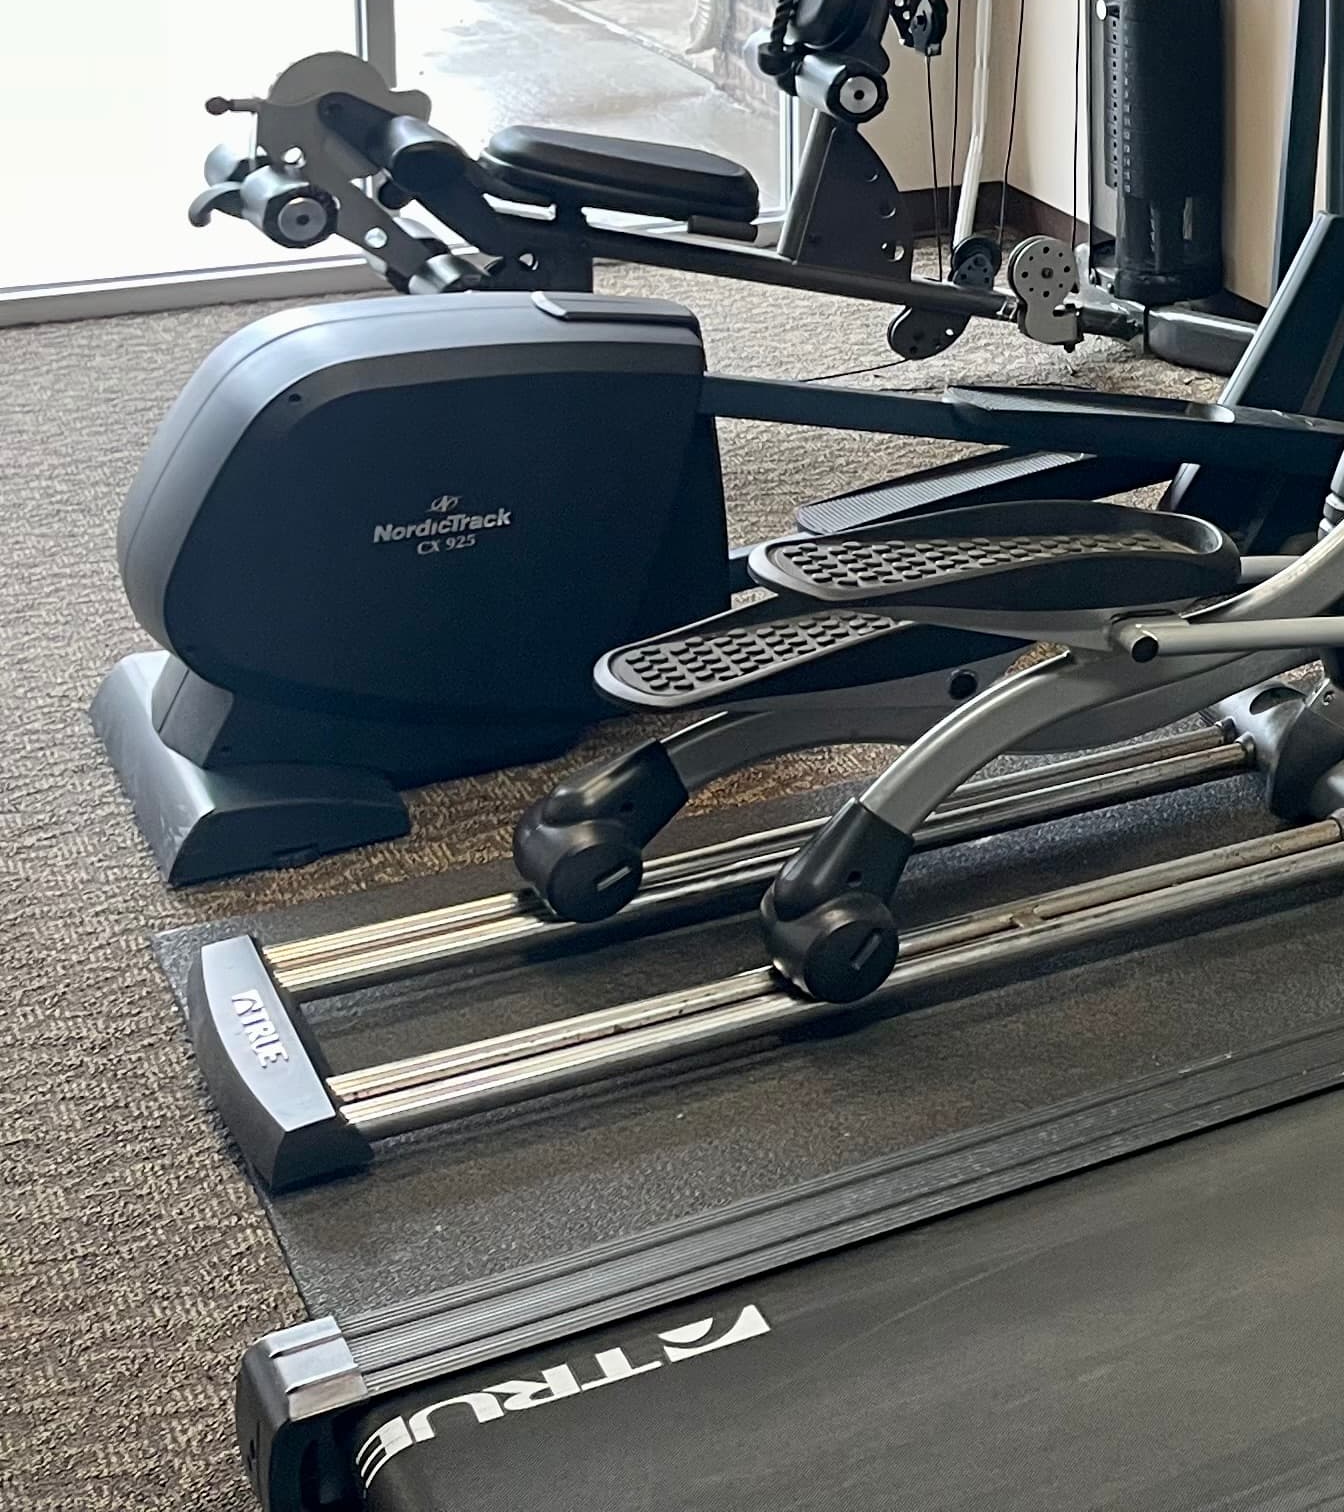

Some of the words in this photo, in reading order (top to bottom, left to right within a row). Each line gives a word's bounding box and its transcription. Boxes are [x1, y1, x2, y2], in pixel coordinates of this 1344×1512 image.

[373, 508, 511, 543] NordicTrack
[417, 541, 440, 555] CX
[445, 534, 476, 551] 925
[355, 1346, 664, 1489] TRUE
